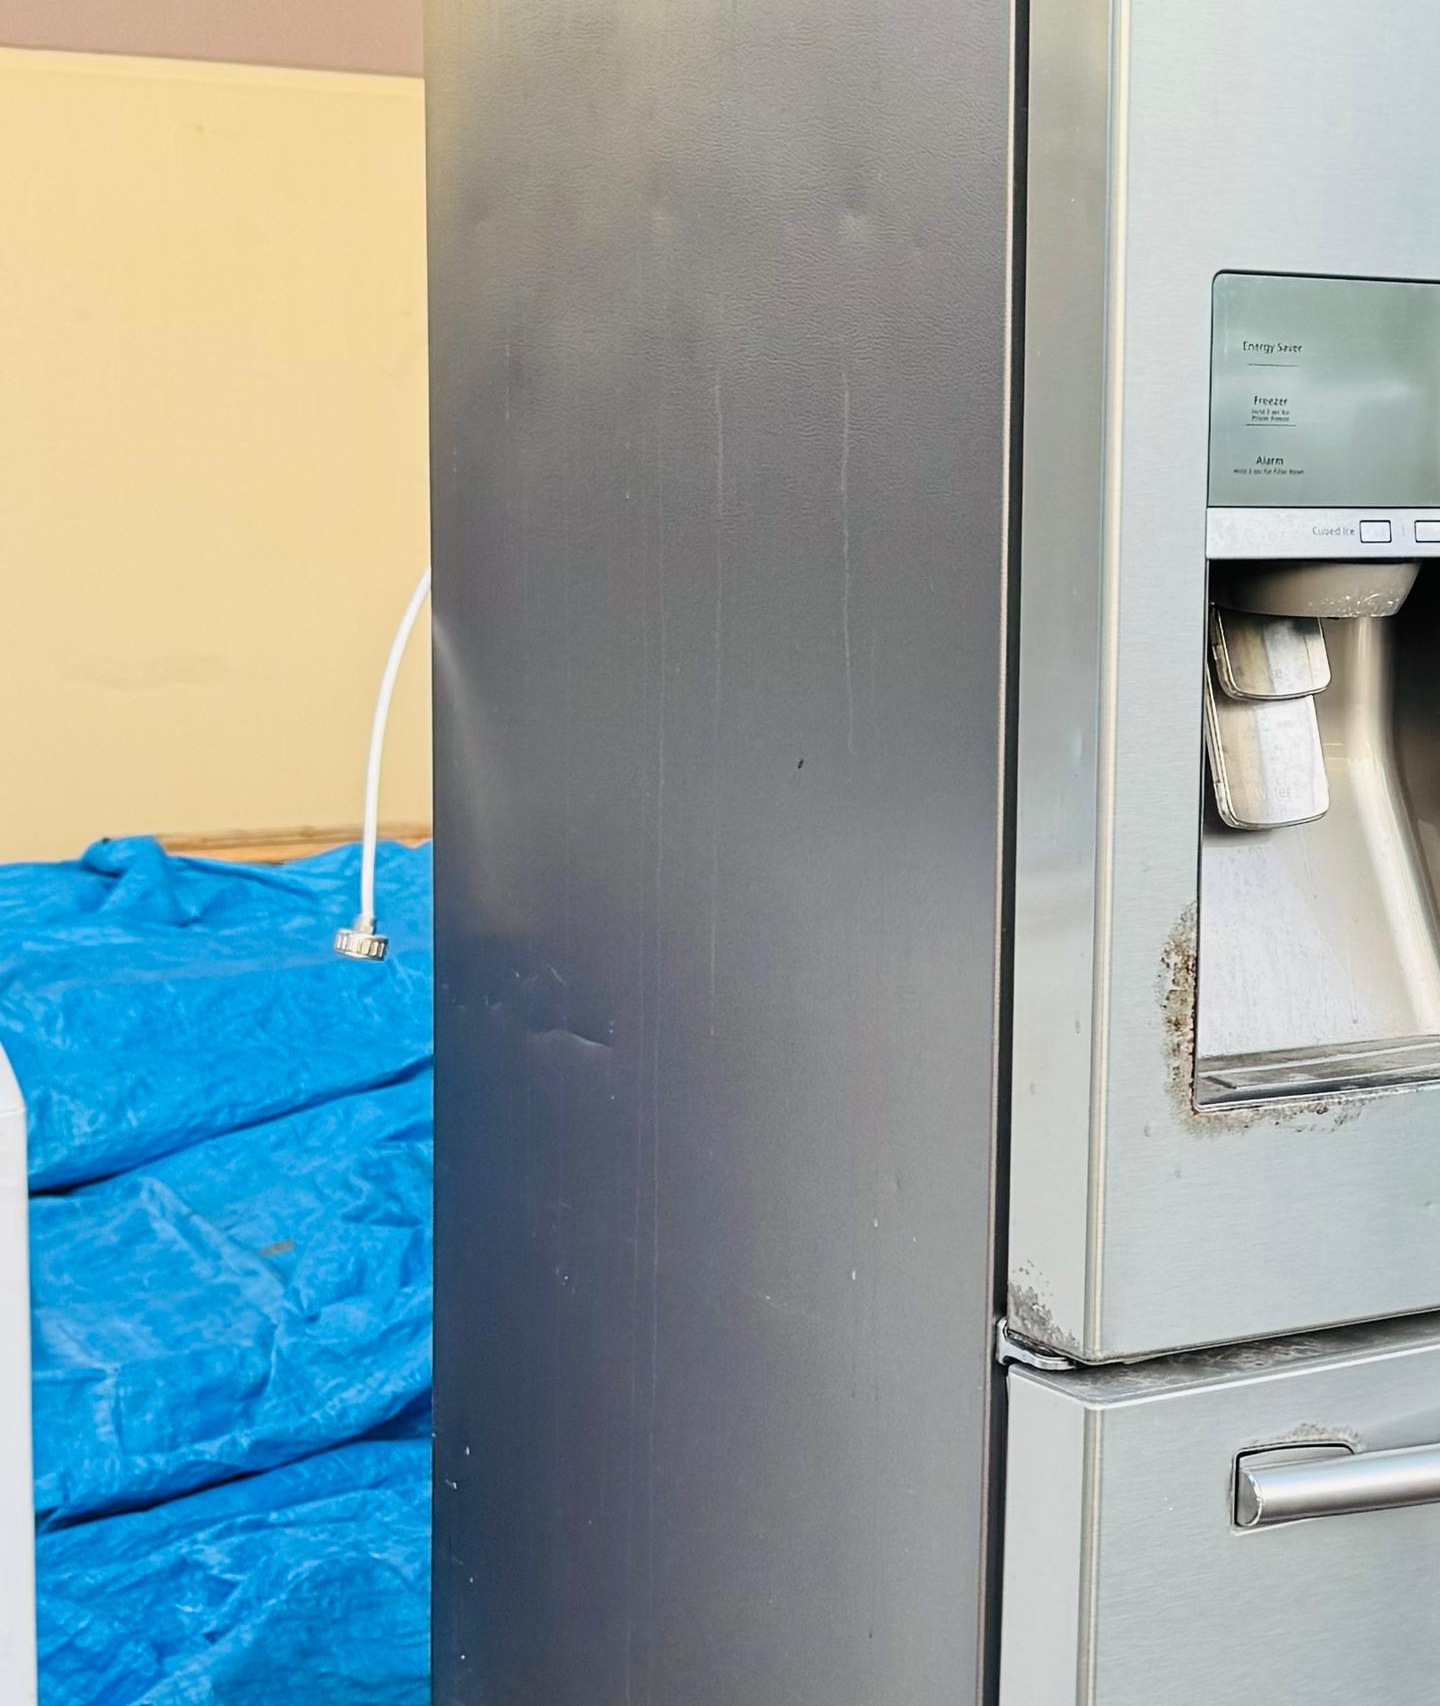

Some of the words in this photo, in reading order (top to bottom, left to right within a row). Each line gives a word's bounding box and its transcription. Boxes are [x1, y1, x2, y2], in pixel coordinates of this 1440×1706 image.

[1243, 340, 1275, 354] Energy
[1253, 395, 1288, 406] Freezer
[1255, 455, 1284, 466] Alarm
